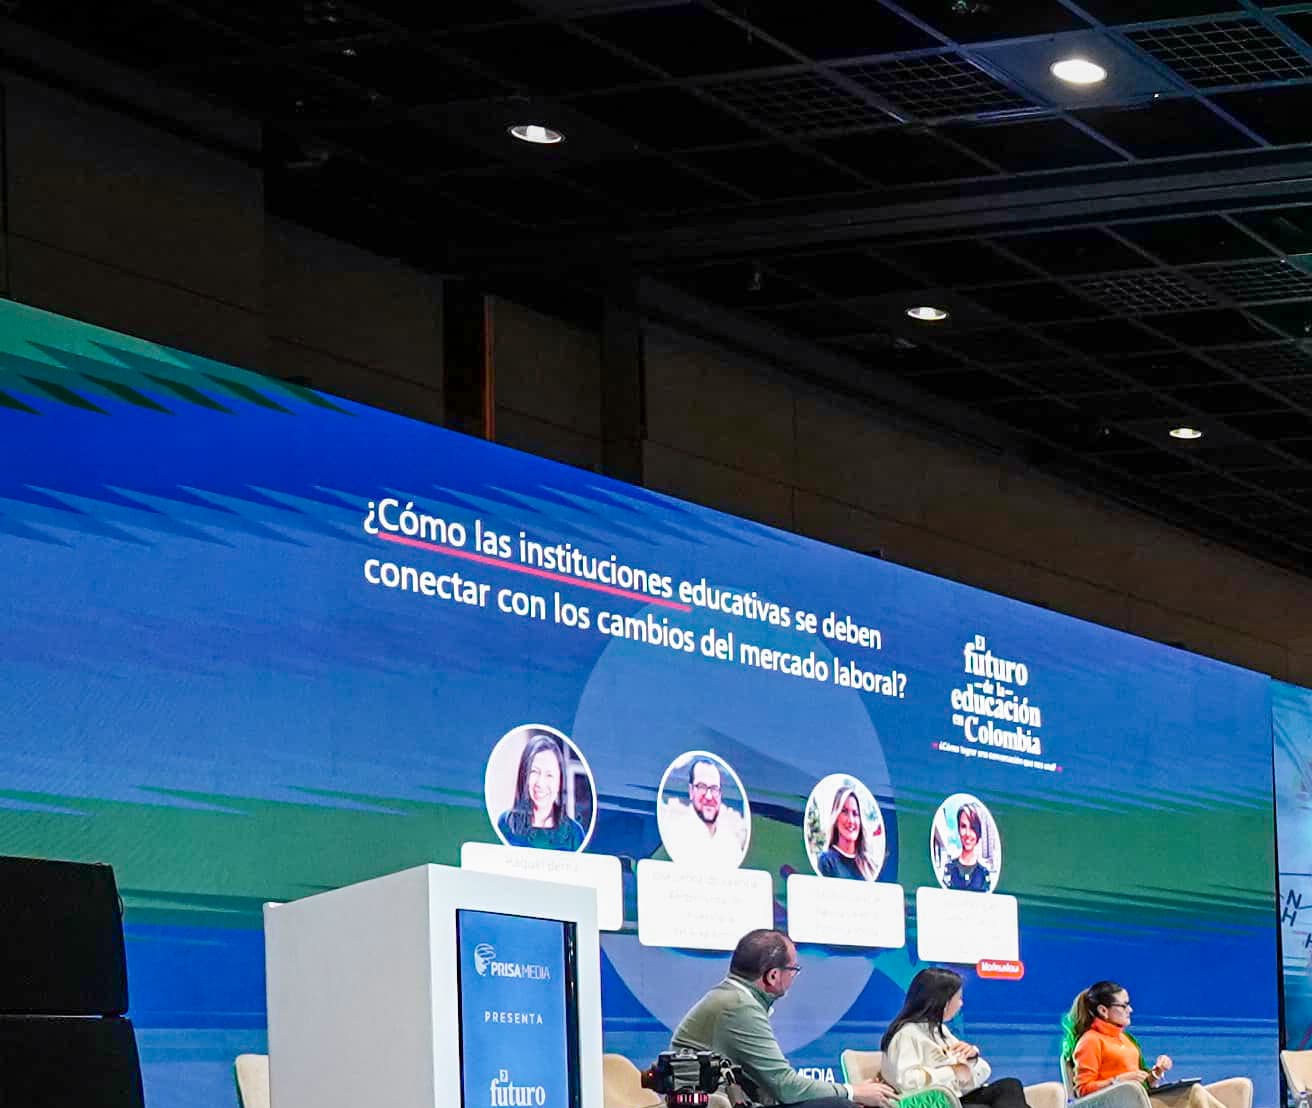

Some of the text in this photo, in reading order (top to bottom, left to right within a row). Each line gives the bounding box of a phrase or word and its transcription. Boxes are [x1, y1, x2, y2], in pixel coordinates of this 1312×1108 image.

[364, 498, 882, 650] ¿Cómo las instituciones educativas se deben
[364, 559, 907, 699] conectar con los cambios del mercado laboral?
[963, 642, 1029, 687] futuro
[951, 683, 1042, 727] educación
[964, 716, 1042, 755] Colombia
[484, 1011, 544, 1025] PRESENTA
[490, 1078, 546, 1107] futuro
